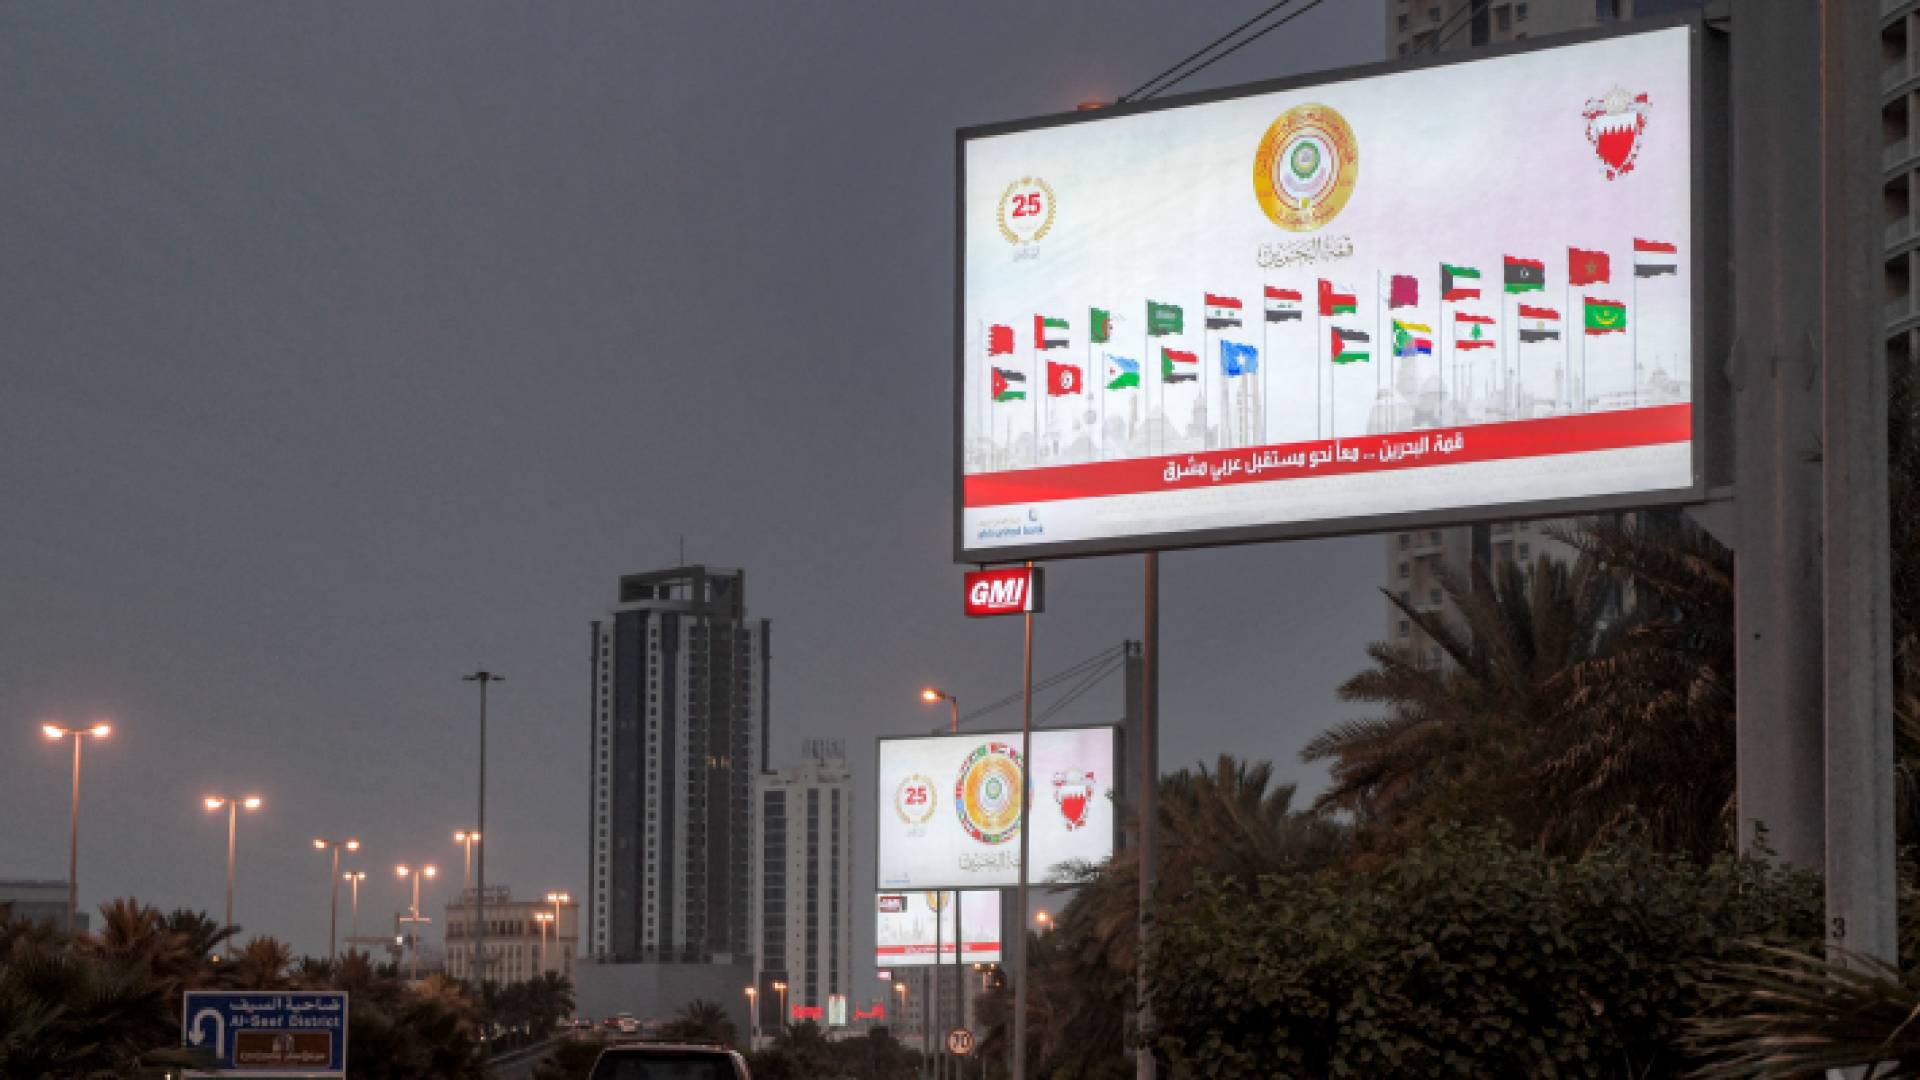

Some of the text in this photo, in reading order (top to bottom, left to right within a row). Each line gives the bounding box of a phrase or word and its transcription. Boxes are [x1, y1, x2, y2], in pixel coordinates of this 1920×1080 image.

[1012, 192, 1042, 217] 25
[1379, 434, 1430, 463] البحرين
[1434, 432, 1464, 454] قمة
[1163, 455, 1208, 482] مشرق
[1245, 450, 1306, 474] مستقبل
[1309, 445, 1332, 468] نحو
[1209, 457, 1243, 482] عربي
[970, 577, 1025, 606] GMI
[904, 784, 928, 806] 25
[1831, 917, 1845, 938] 3
[229, 1014, 340, 1027] Al-Seef District
